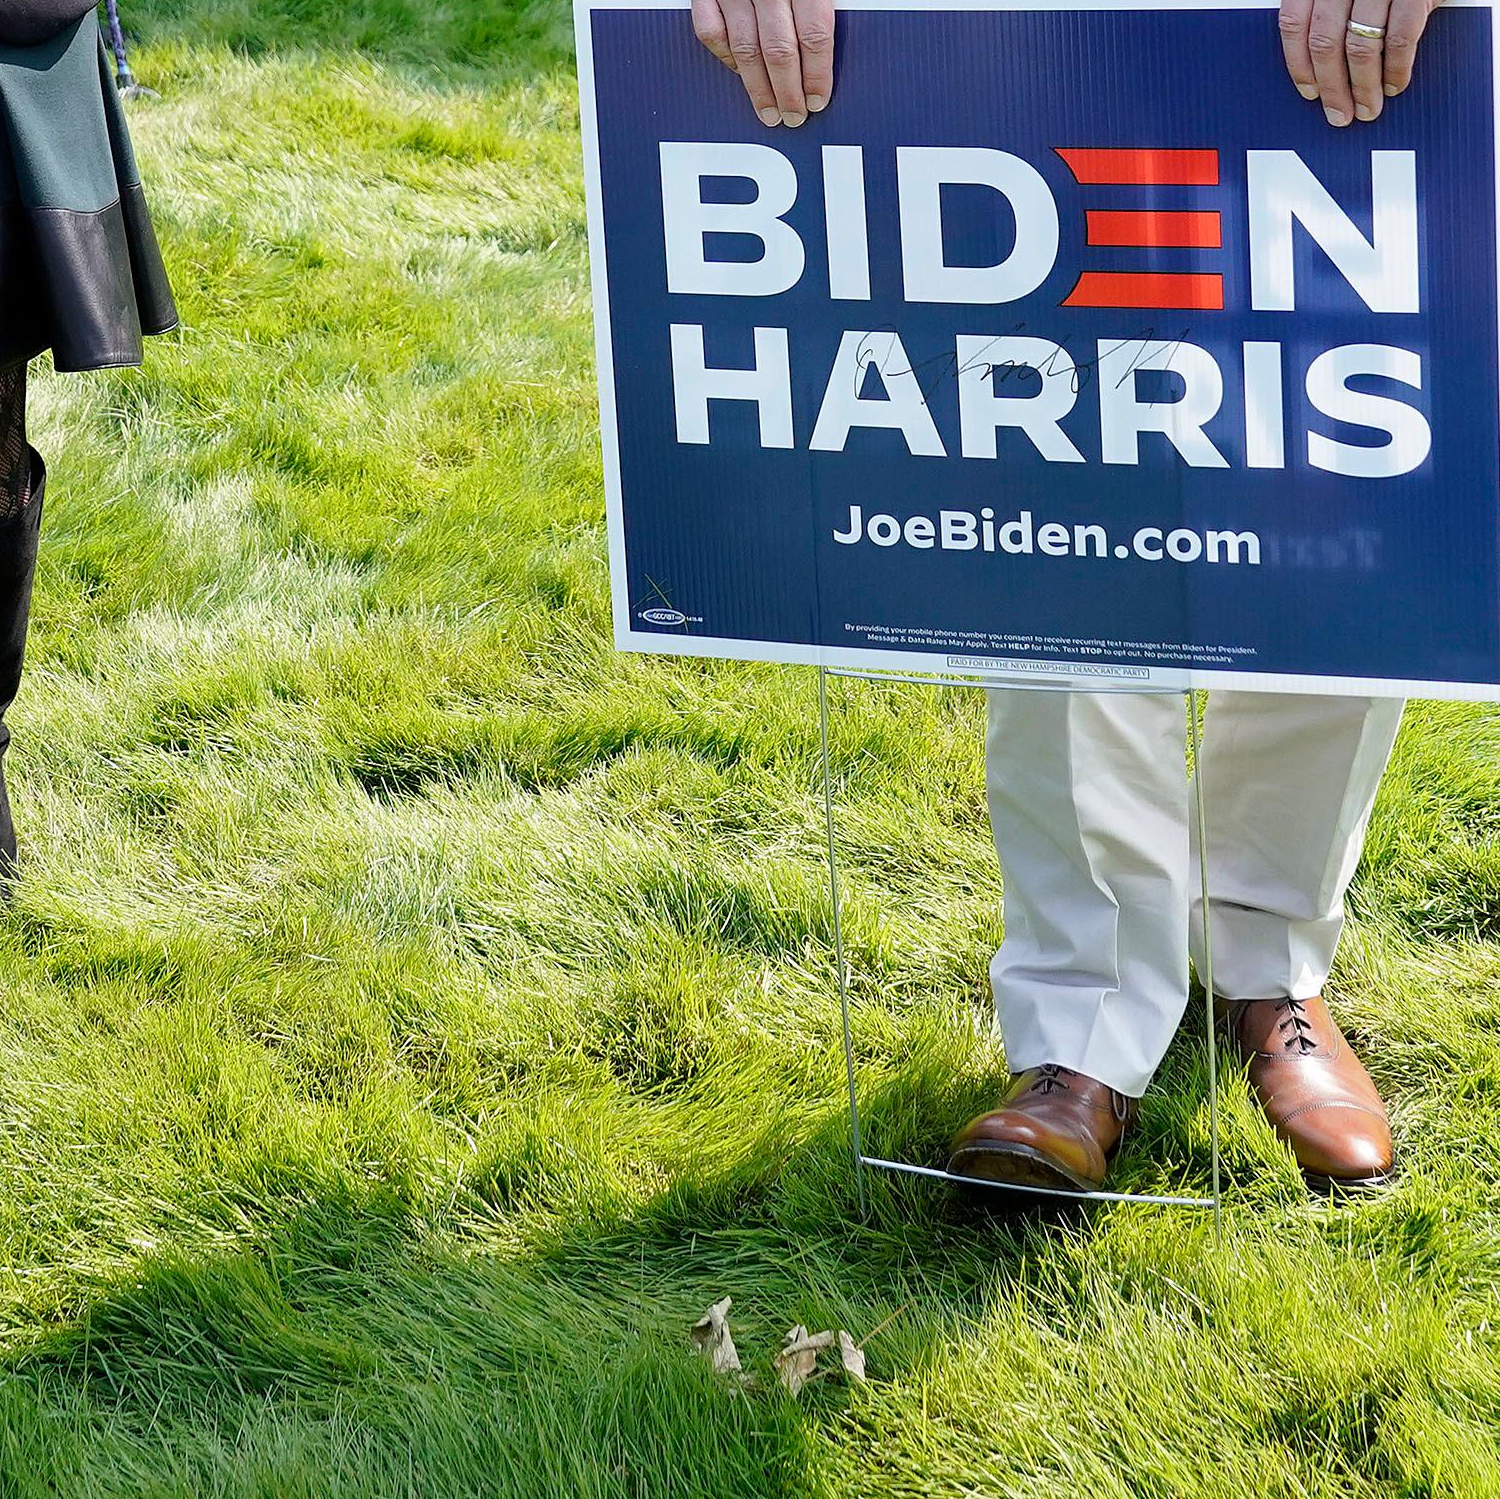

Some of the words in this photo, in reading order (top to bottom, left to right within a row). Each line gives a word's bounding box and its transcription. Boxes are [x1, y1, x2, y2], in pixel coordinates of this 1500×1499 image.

[658, 140, 1420, 315] BIDEN
[669, 322, 1433, 479] HARRIS
[831, 504, 1263, 566] JoeBiden.com
[844, 623, 854, 631] By
[856, 624, 889, 633] providing
[934, 629, 957, 637] phone
[958, 630, 987, 638] number
[1044, 635, 1071, 643] receive
[1072, 637, 1105, 646] recurring
[1122, 641, 1160, 650] messages
[1182, 643, 1204, 651] Biden
[867, 633, 898, 642] Message
[948, 638, 964, 646] May
[1112, 648, 1126, 656] opt
[1156, 651, 1192, 660] purchase
